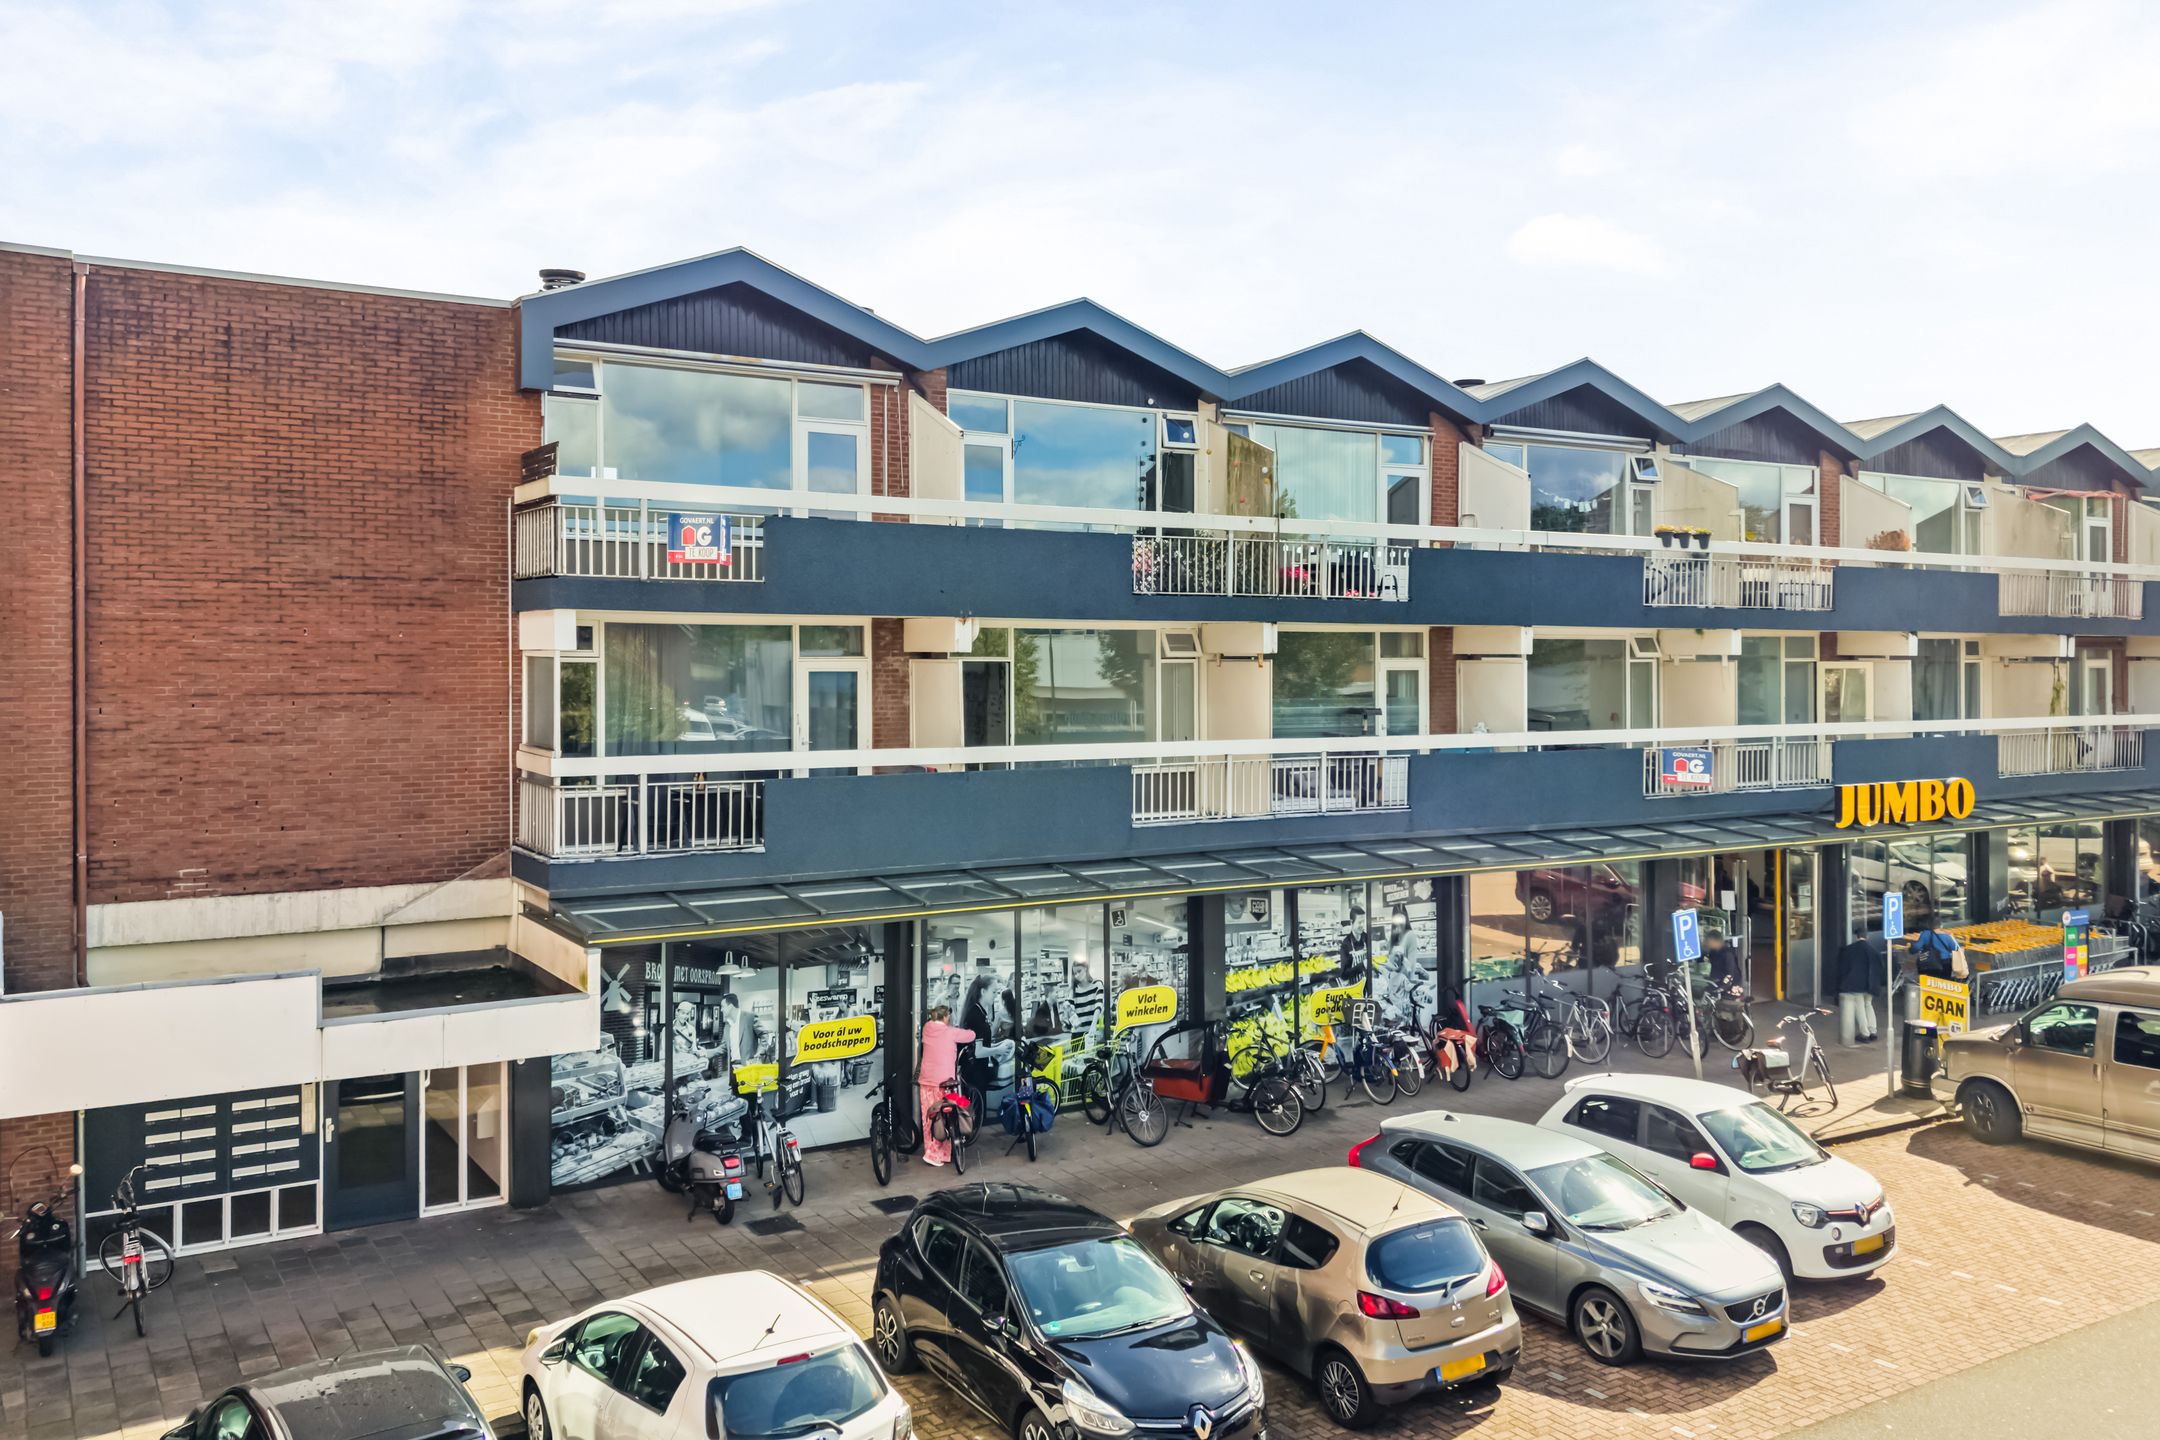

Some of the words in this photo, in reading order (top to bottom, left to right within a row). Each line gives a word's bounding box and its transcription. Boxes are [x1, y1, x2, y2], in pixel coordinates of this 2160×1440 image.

[697, 526, 712, 546] G
[699, 548, 713, 557] KOOP
[1690, 759, 1704, 773] G
[1835, 777, 1976, 829] JUMBO
[1889, 898, 1899, 920] P
[1679, 915, 1692, 941] P
[645, 962, 662, 980] BRO
[1927, 977, 1962, 993] JUMBO
[1137, 994, 1157, 1005] Vlot
[1924, 995, 1965, 1018] GAAN
[1126, 1004, 1168, 1018] winkelen
[813, 1030, 835, 1039] Voor
[836, 1026, 846, 1036] ál
[847, 1027, 862, 1035] uw
[803, 1036, 871, 1052] boodschappen
